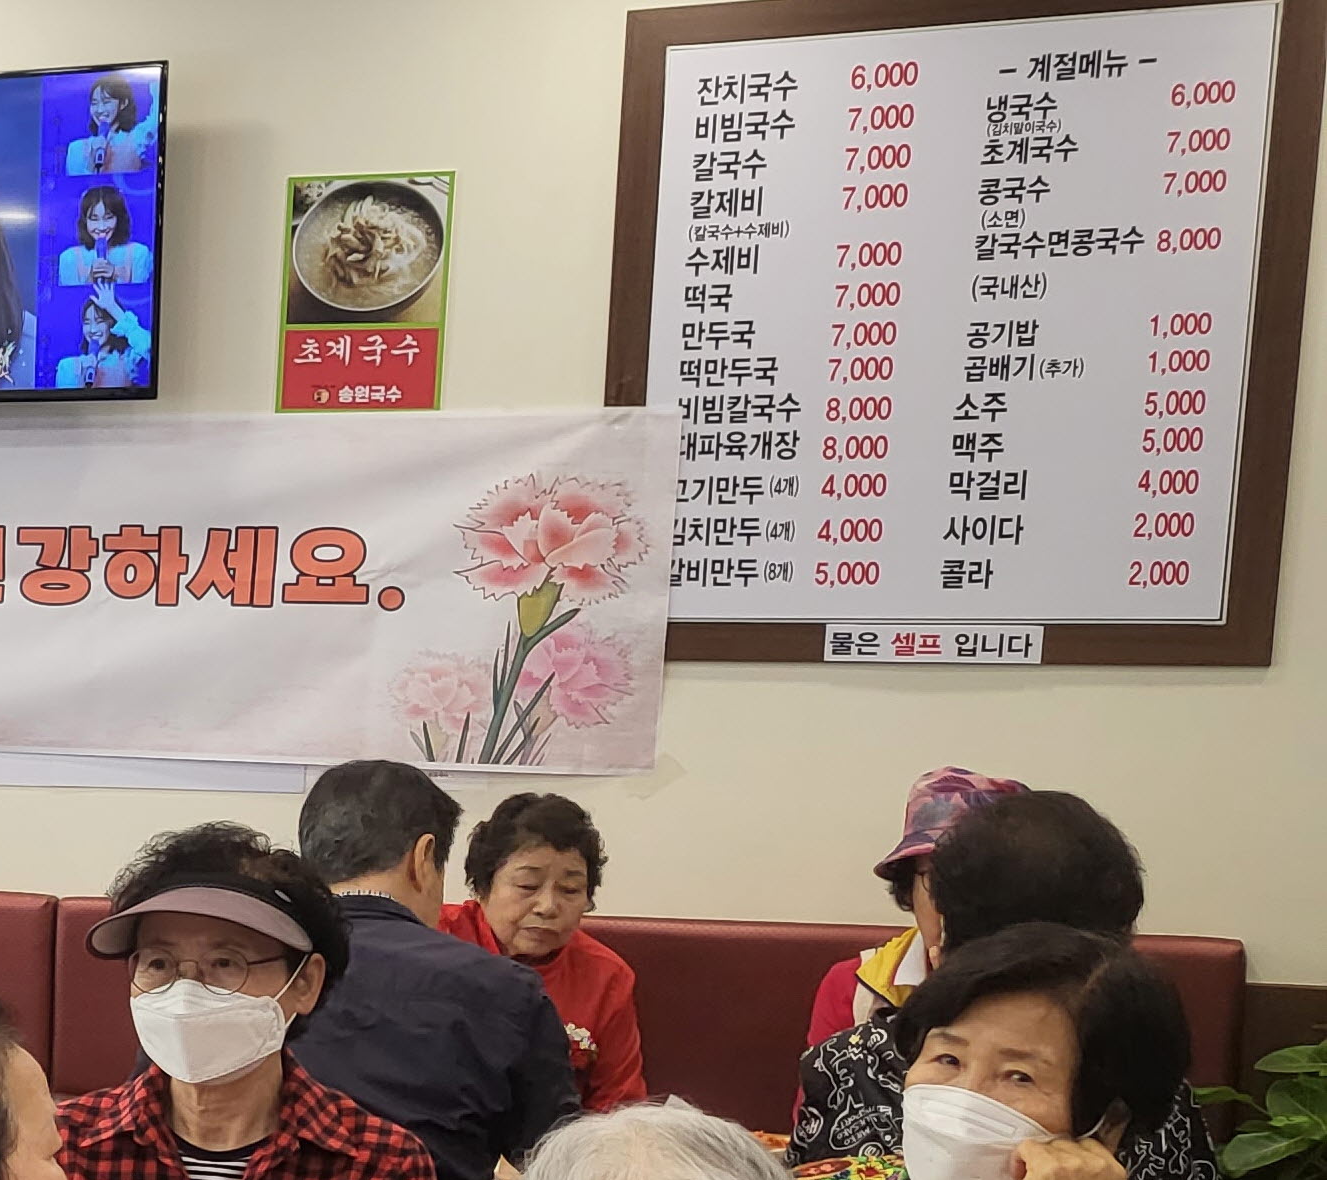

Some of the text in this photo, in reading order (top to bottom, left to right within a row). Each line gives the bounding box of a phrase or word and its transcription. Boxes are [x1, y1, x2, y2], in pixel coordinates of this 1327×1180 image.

[1027, 50, 1128, 82] 계절메뉴
[698, 62, 918, 106] 잔치국수 6,000
[987, 80, 1235, 123] 냉국수 6,000
[696, 104, 914, 143] 비빔국수 7,000
[693, 144, 911, 181] 칼국수 7,000
[981, 128, 1230, 165] 초계국수 7,000
[691, 183, 908, 219] 칼제비 7,000
[978, 170, 1226, 205] 콩국수 7,000
[689, 218, 789, 245] (칼국수+수제비)
[982, 209, 1025, 230] (소면)
[975, 224, 1221, 260] 칼국수면콩국수 8,000
[685, 242, 902, 277] 수제비 7,000
[685, 282, 900, 314] 떡국 7,000
[972, 272, 1046, 302] (국내산)
[682, 321, 896, 350] 만두국 7,000
[967, 313, 1212, 349] 공기밥 1,000
[293, 333, 419, 366] 초계국수
[1149, 350, 1210, 375] 1,000
[680, 356, 893, 388] 떡만두국 7,000
[339, 385, 401, 402] 송원국수
[679, 393, 891, 424] 비빔칼국수 8,000
[953, 390, 1206, 422] 소주 5,000
[823, 435, 888, 463] 8,000
[953, 427, 1203, 463] 맥주 5,000
[770, 476, 799, 498] (4개)
[821, 473, 886, 500] 4,000
[950, 470, 1199, 501] 막걸리 4,000
[766, 520, 795, 542] (4개)
[818, 519, 882, 545] 4,000
[943, 513, 1194, 545] 사이다 2,000
[764, 561, 793, 582] (8개)
[815, 562, 879, 588] 5,000
[941, 559, 1189, 589] 콜라 2,000
[830, 632, 1033, 658] 물은 셀프 입니다
